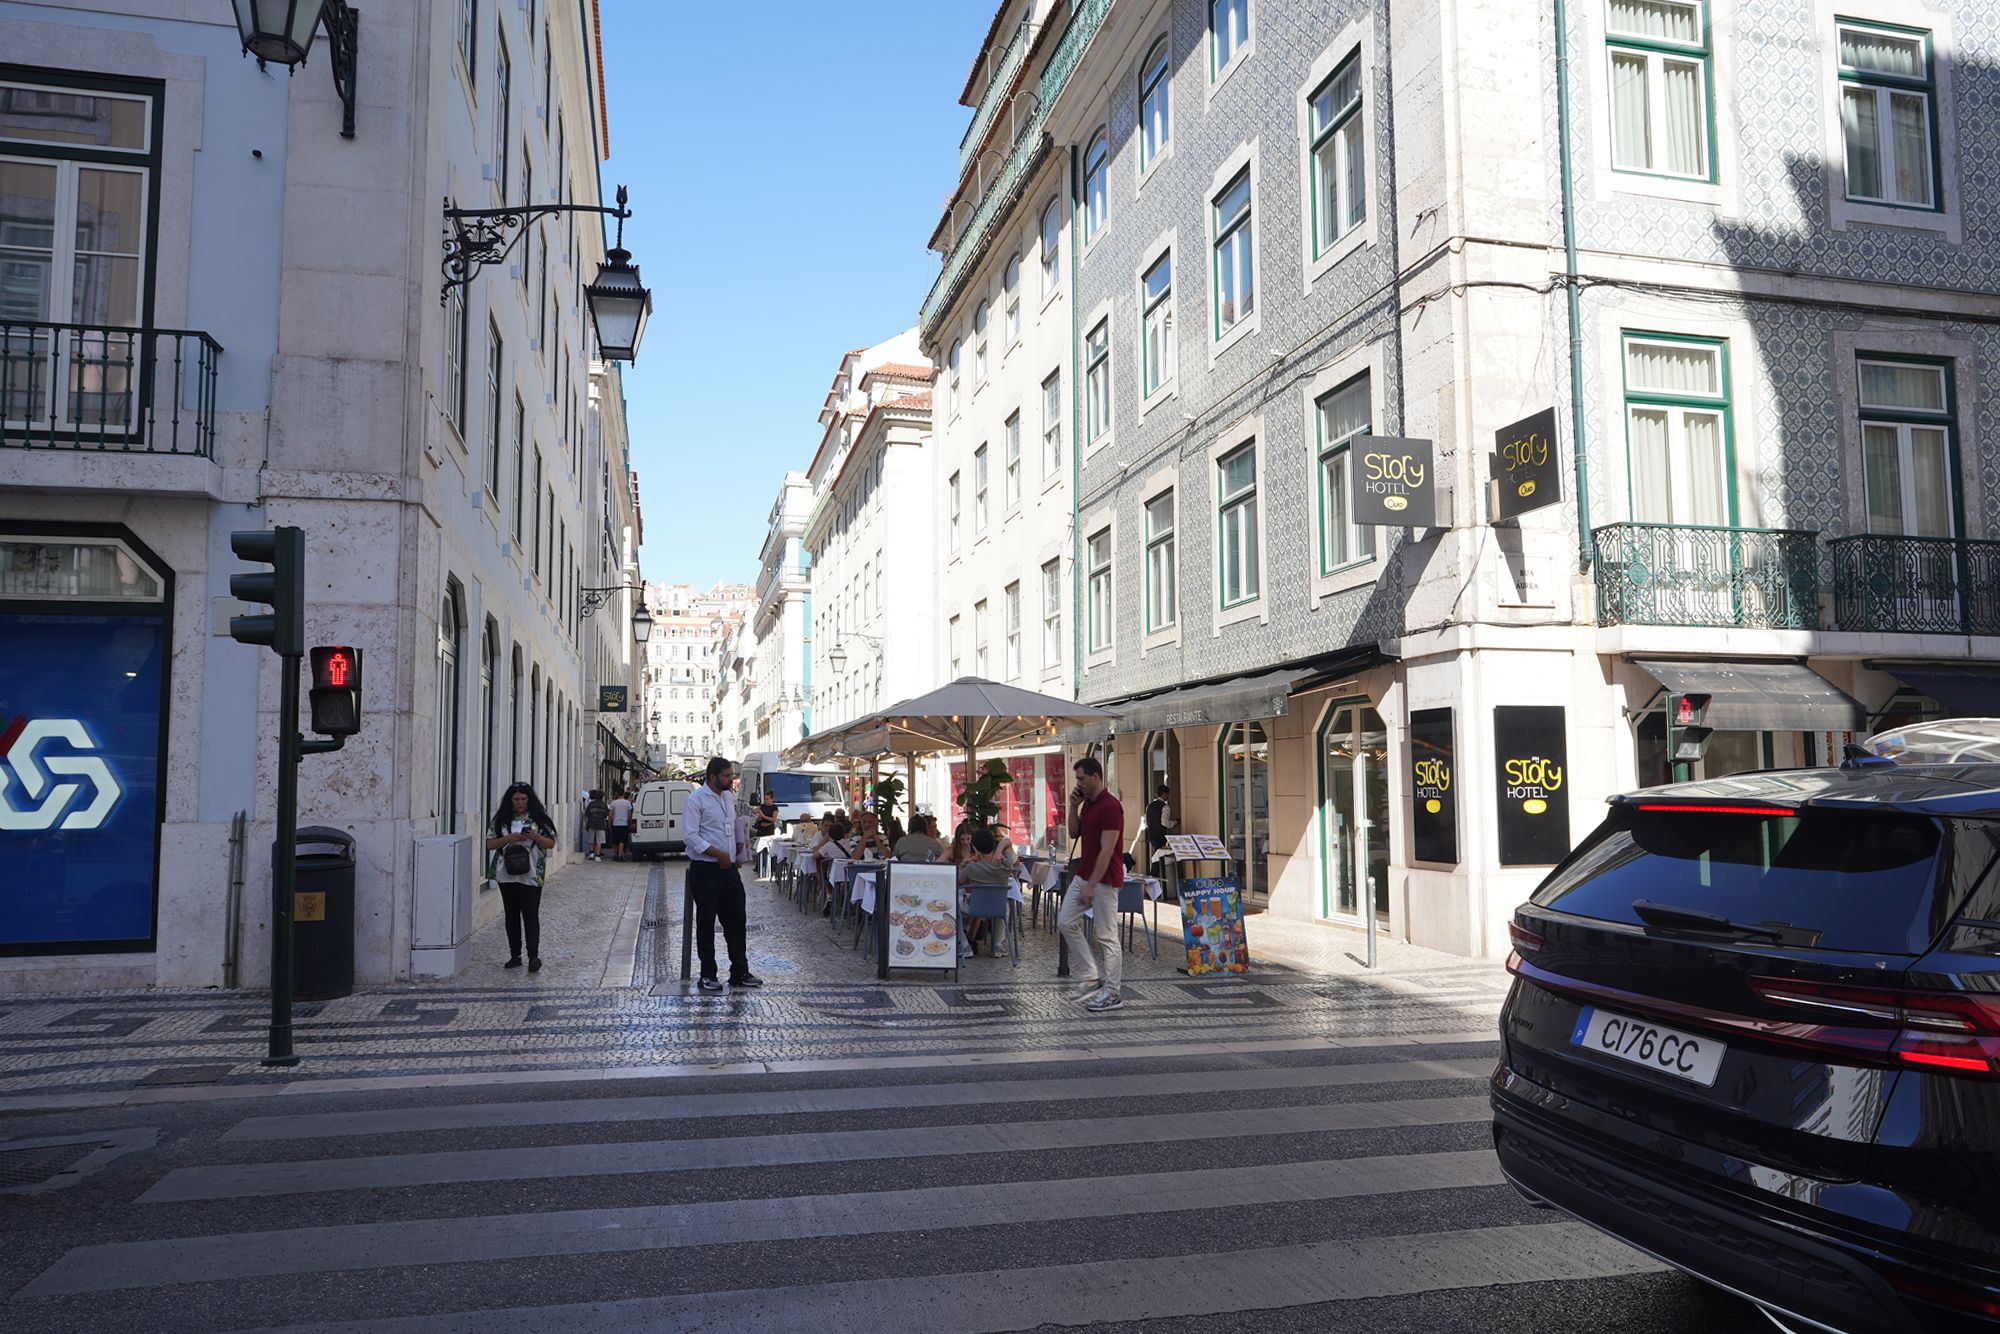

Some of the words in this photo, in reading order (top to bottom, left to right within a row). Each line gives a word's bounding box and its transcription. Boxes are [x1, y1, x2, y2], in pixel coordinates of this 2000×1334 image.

[1365, 482, 1410, 496] HOTEL
[1166, 710, 1202, 725] RESTAURANTE
[1416, 787, 1442, 798] HOTEL
[1507, 786, 1548, 798] HOTEL
[1195, 879, 1225, 889] OURO
[1184, 889, 1212, 898] HAPPY
[1213, 886, 1236, 895] HOUR
